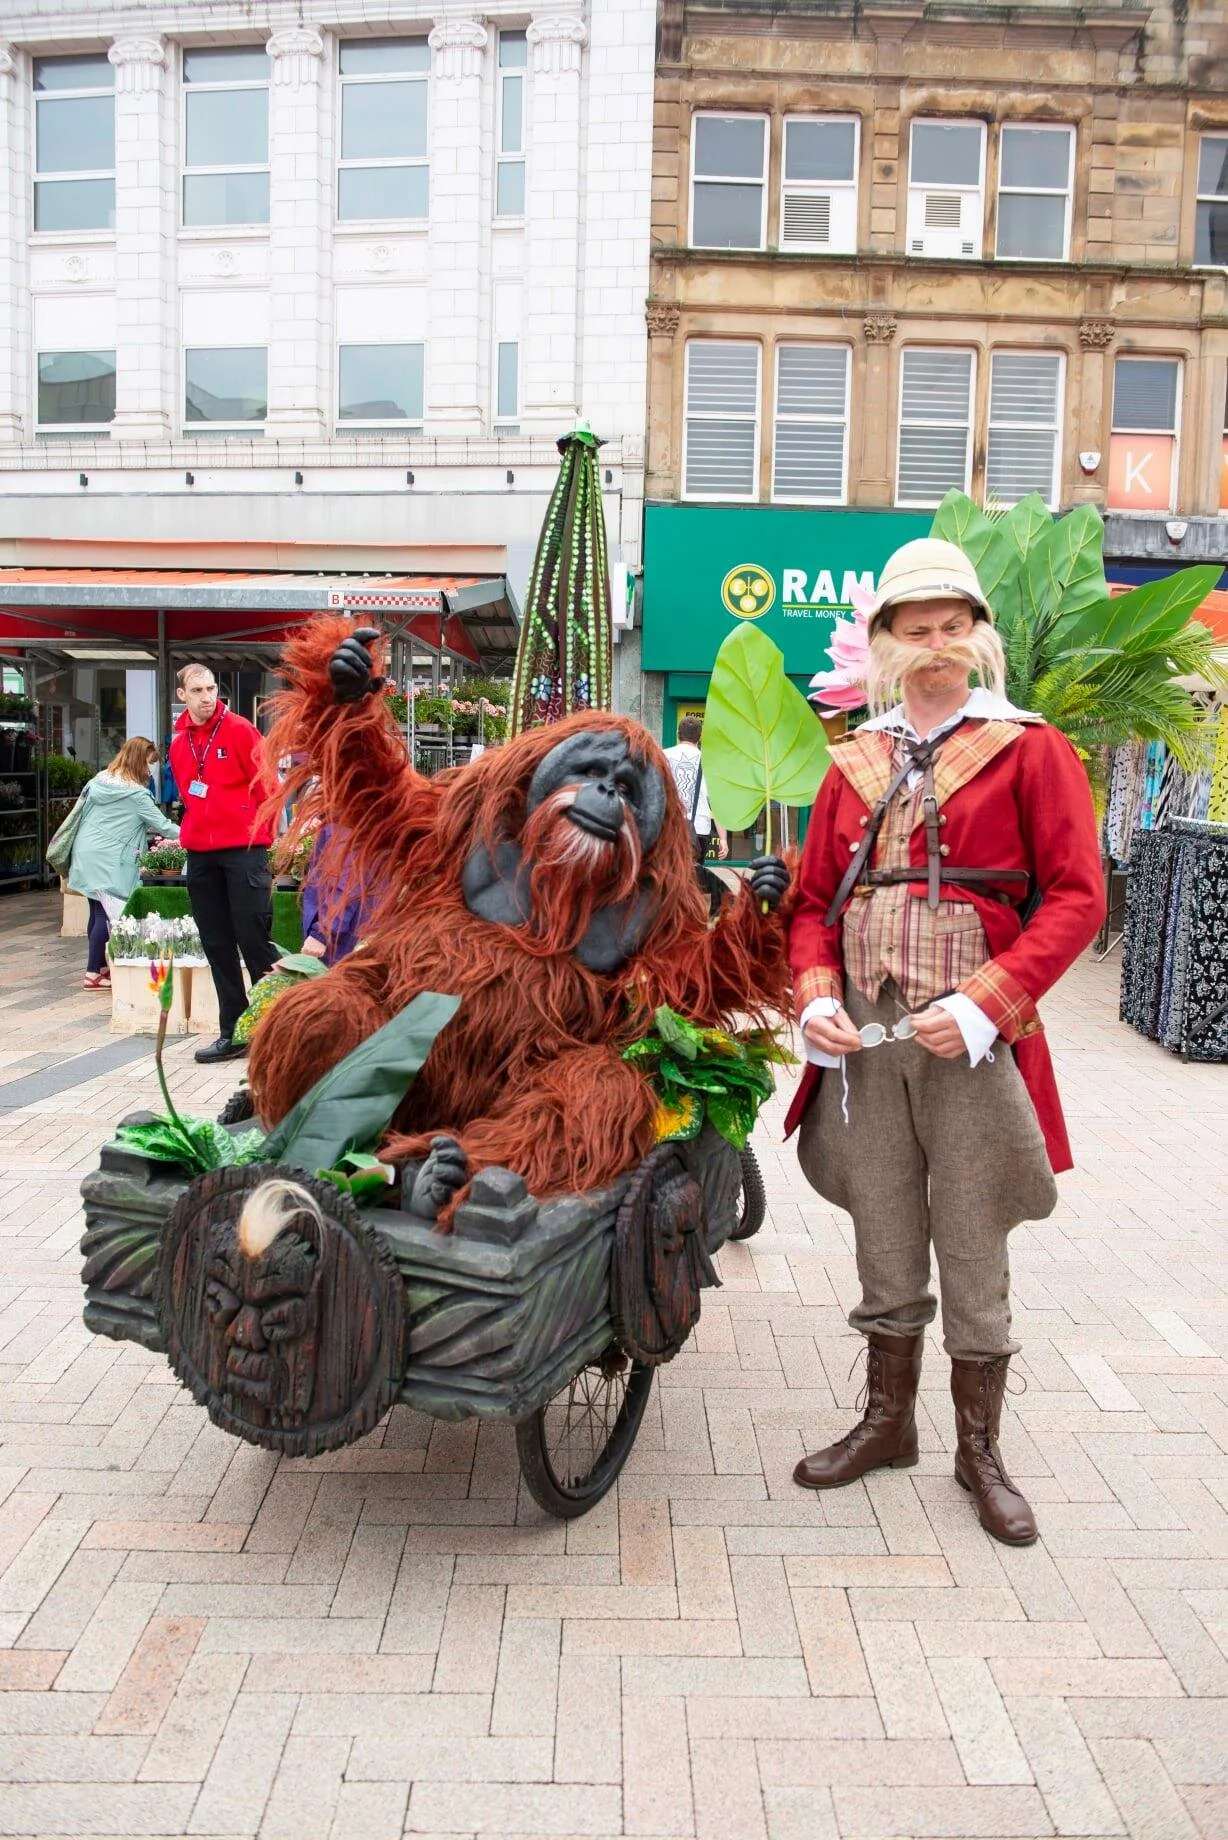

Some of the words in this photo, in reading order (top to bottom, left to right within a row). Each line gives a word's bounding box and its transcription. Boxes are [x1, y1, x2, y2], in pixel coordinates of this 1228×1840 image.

[1125, 451, 1154, 494] K
[332, 594, 340, 604] B
[782, 609, 813, 618] TRAVEL
[815, 610, 847, 619] MONEY
